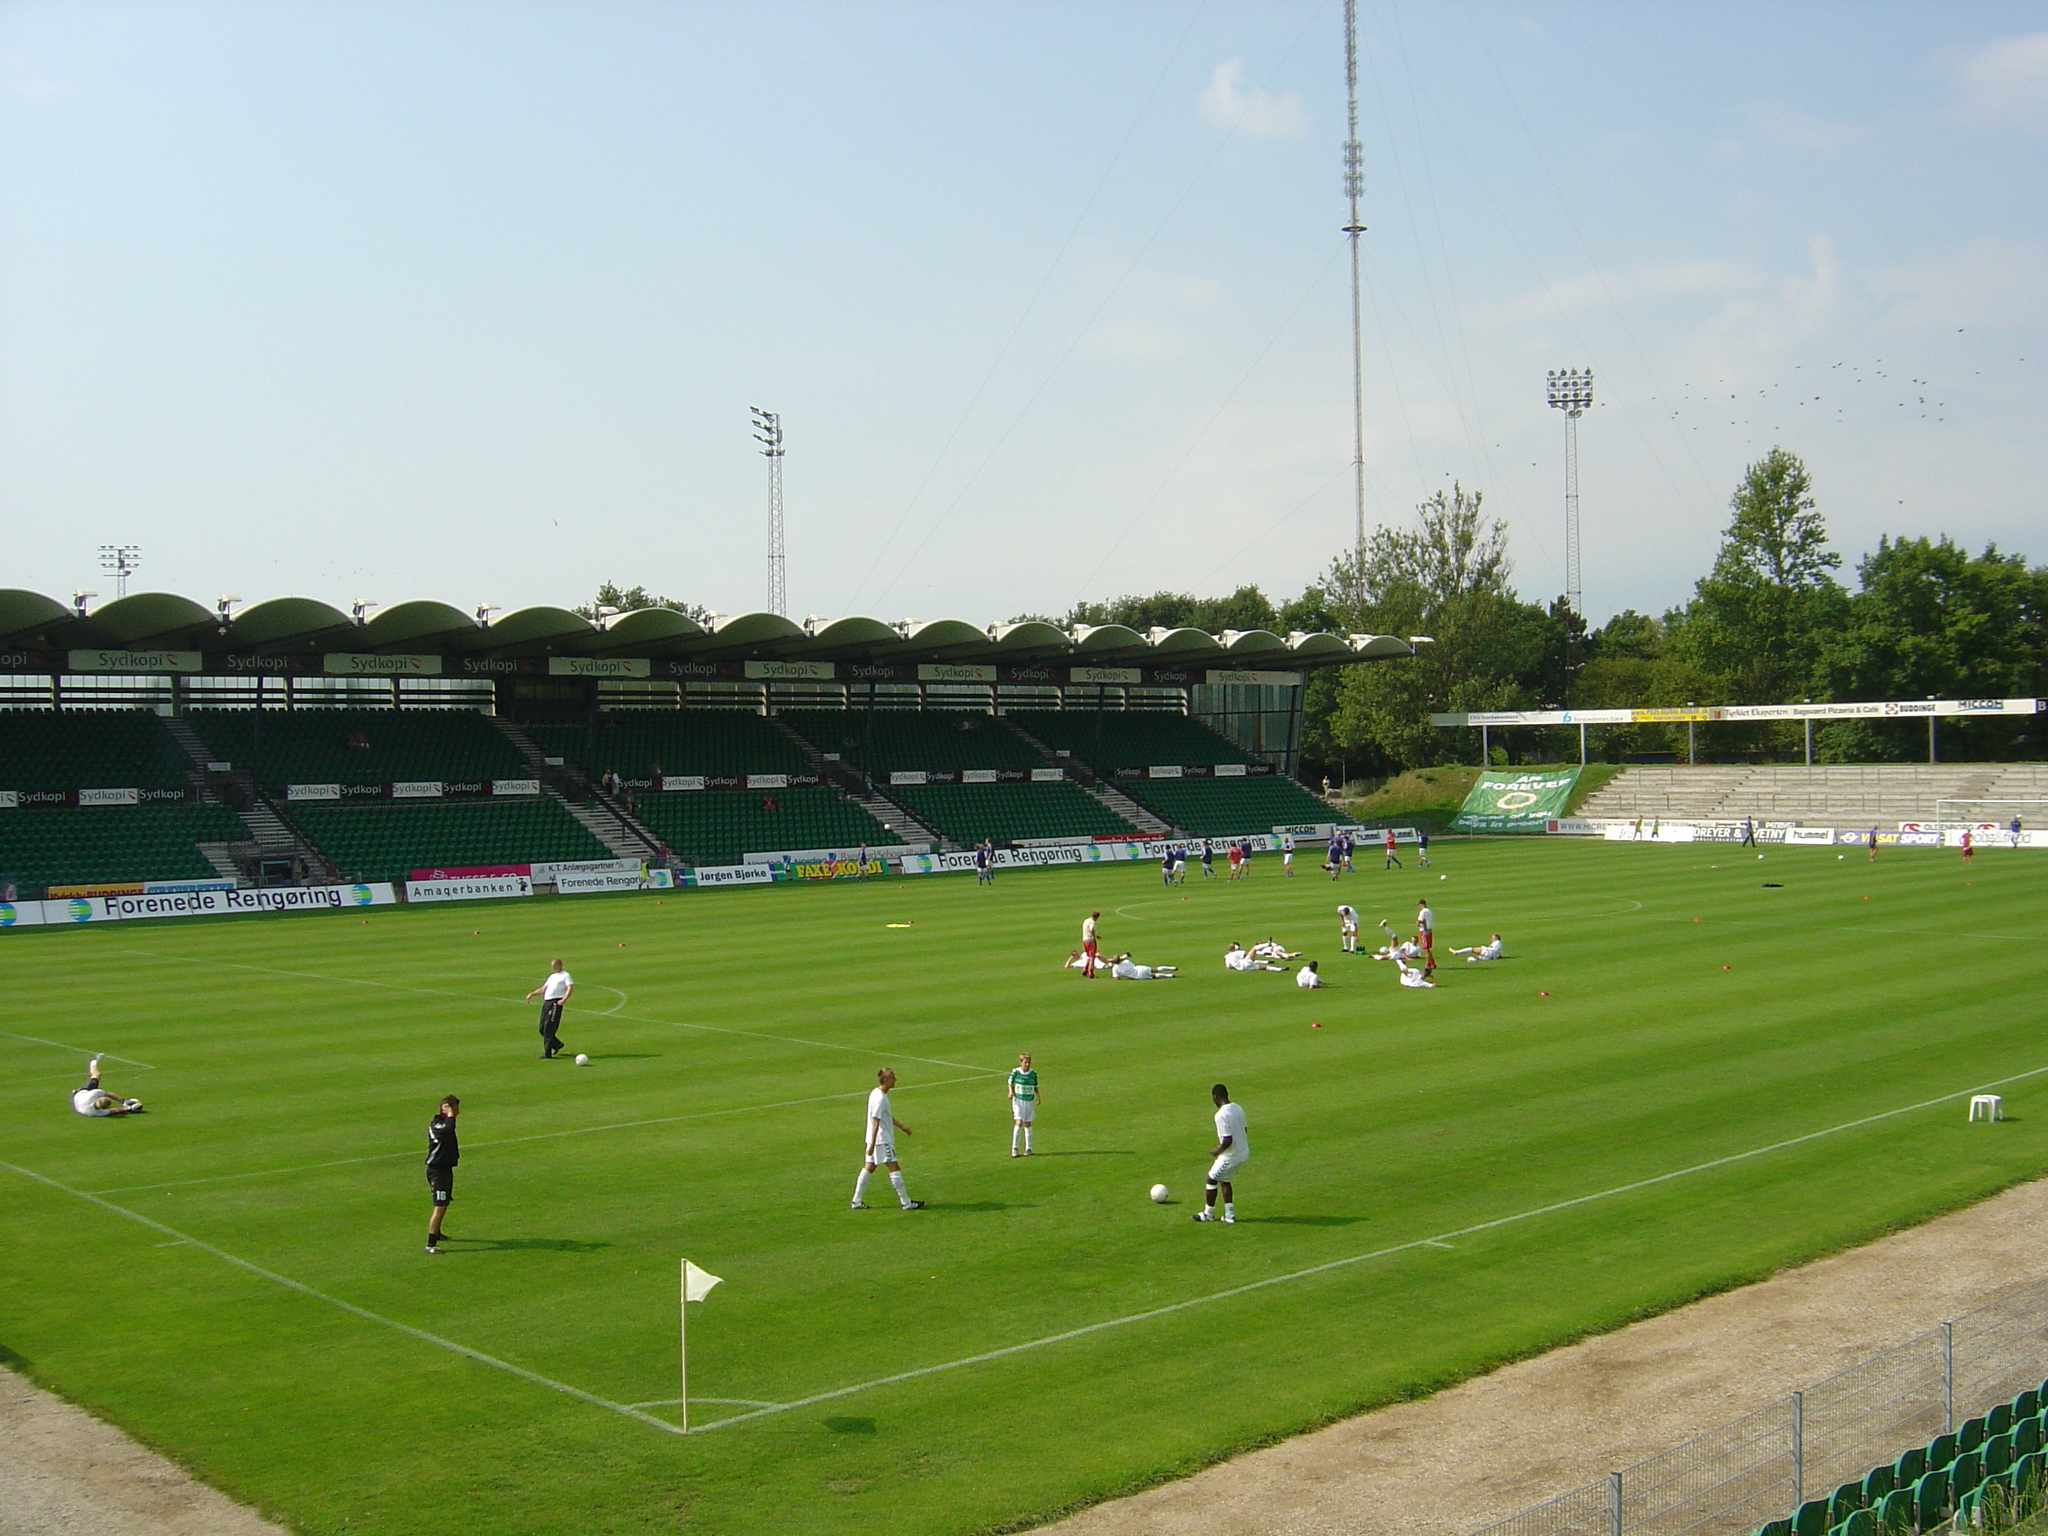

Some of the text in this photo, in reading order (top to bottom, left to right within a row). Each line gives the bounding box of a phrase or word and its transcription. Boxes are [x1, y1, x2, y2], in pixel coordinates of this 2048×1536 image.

[99, 653, 163, 669] Sydkopi
[228, 654, 288, 670] Sydkopi
[351, 657, 407, 672] Sydkopi
[464, 658, 518, 673] Sydkopi
[570, 660, 620, 675] Sydkopi
[670, 662, 717, 676] Sydkopi
[764, 663, 808, 678] Sydkopi
[852, 664, 894, 676] Sydkopi
[934, 667, 974, 678] Sydkopi
[1012, 668, 1049, 680] Sydkopi
[1086, 669, 1121, 680] Sydkopi
[1154, 670, 1187, 682] Sydkopi
[1958, 700, 2003, 709] MICCON
[962, 770, 990, 780] Sydkopi
[996, 770, 1024, 780] Sydkopi
[1116, 768, 1141, 778] Sydkopi
[1183, 766, 1207, 775] Sydkopi
[1246, 765, 1269, 774] Sydkopi
[705, 776, 738, 787] Sydkopi
[747, 776, 779, 786] Sydkopi
[788, 775, 818, 785] Sydkopi
[890, 772, 919, 782] Sydkopi
[926, 772, 954, 782] Sydkopi
[444, 782, 482, 794] Sydkopi
[492, 781, 530, 793] Sydkopi
[662, 778, 696, 788] Sydkopi
[140, 788, 184, 800] Sydkopi
[288, 784, 329, 797] Sydkopi
[341, 784, 382, 796] Sydkopi
[392, 783, 432, 796] Sydkopi
[19, 792, 66, 804] Sydkopi
[80, 790, 126, 803] Sydkopi
[1394, 830, 1413, 838] ummel
[1694, 828, 1730, 838] DREYER
[1734, 828, 1742, 838] &
[1794, 830, 1828, 839] hummel
[1900, 833, 1939, 844] SPORT
[1010, 846, 1081, 864] Rengøring
[562, 878, 604, 888] Forenede
[104, 891, 216, 916] Forenede
[225, 886, 342, 910] Rengøring
[436, 1190, 446, 1201] 16
